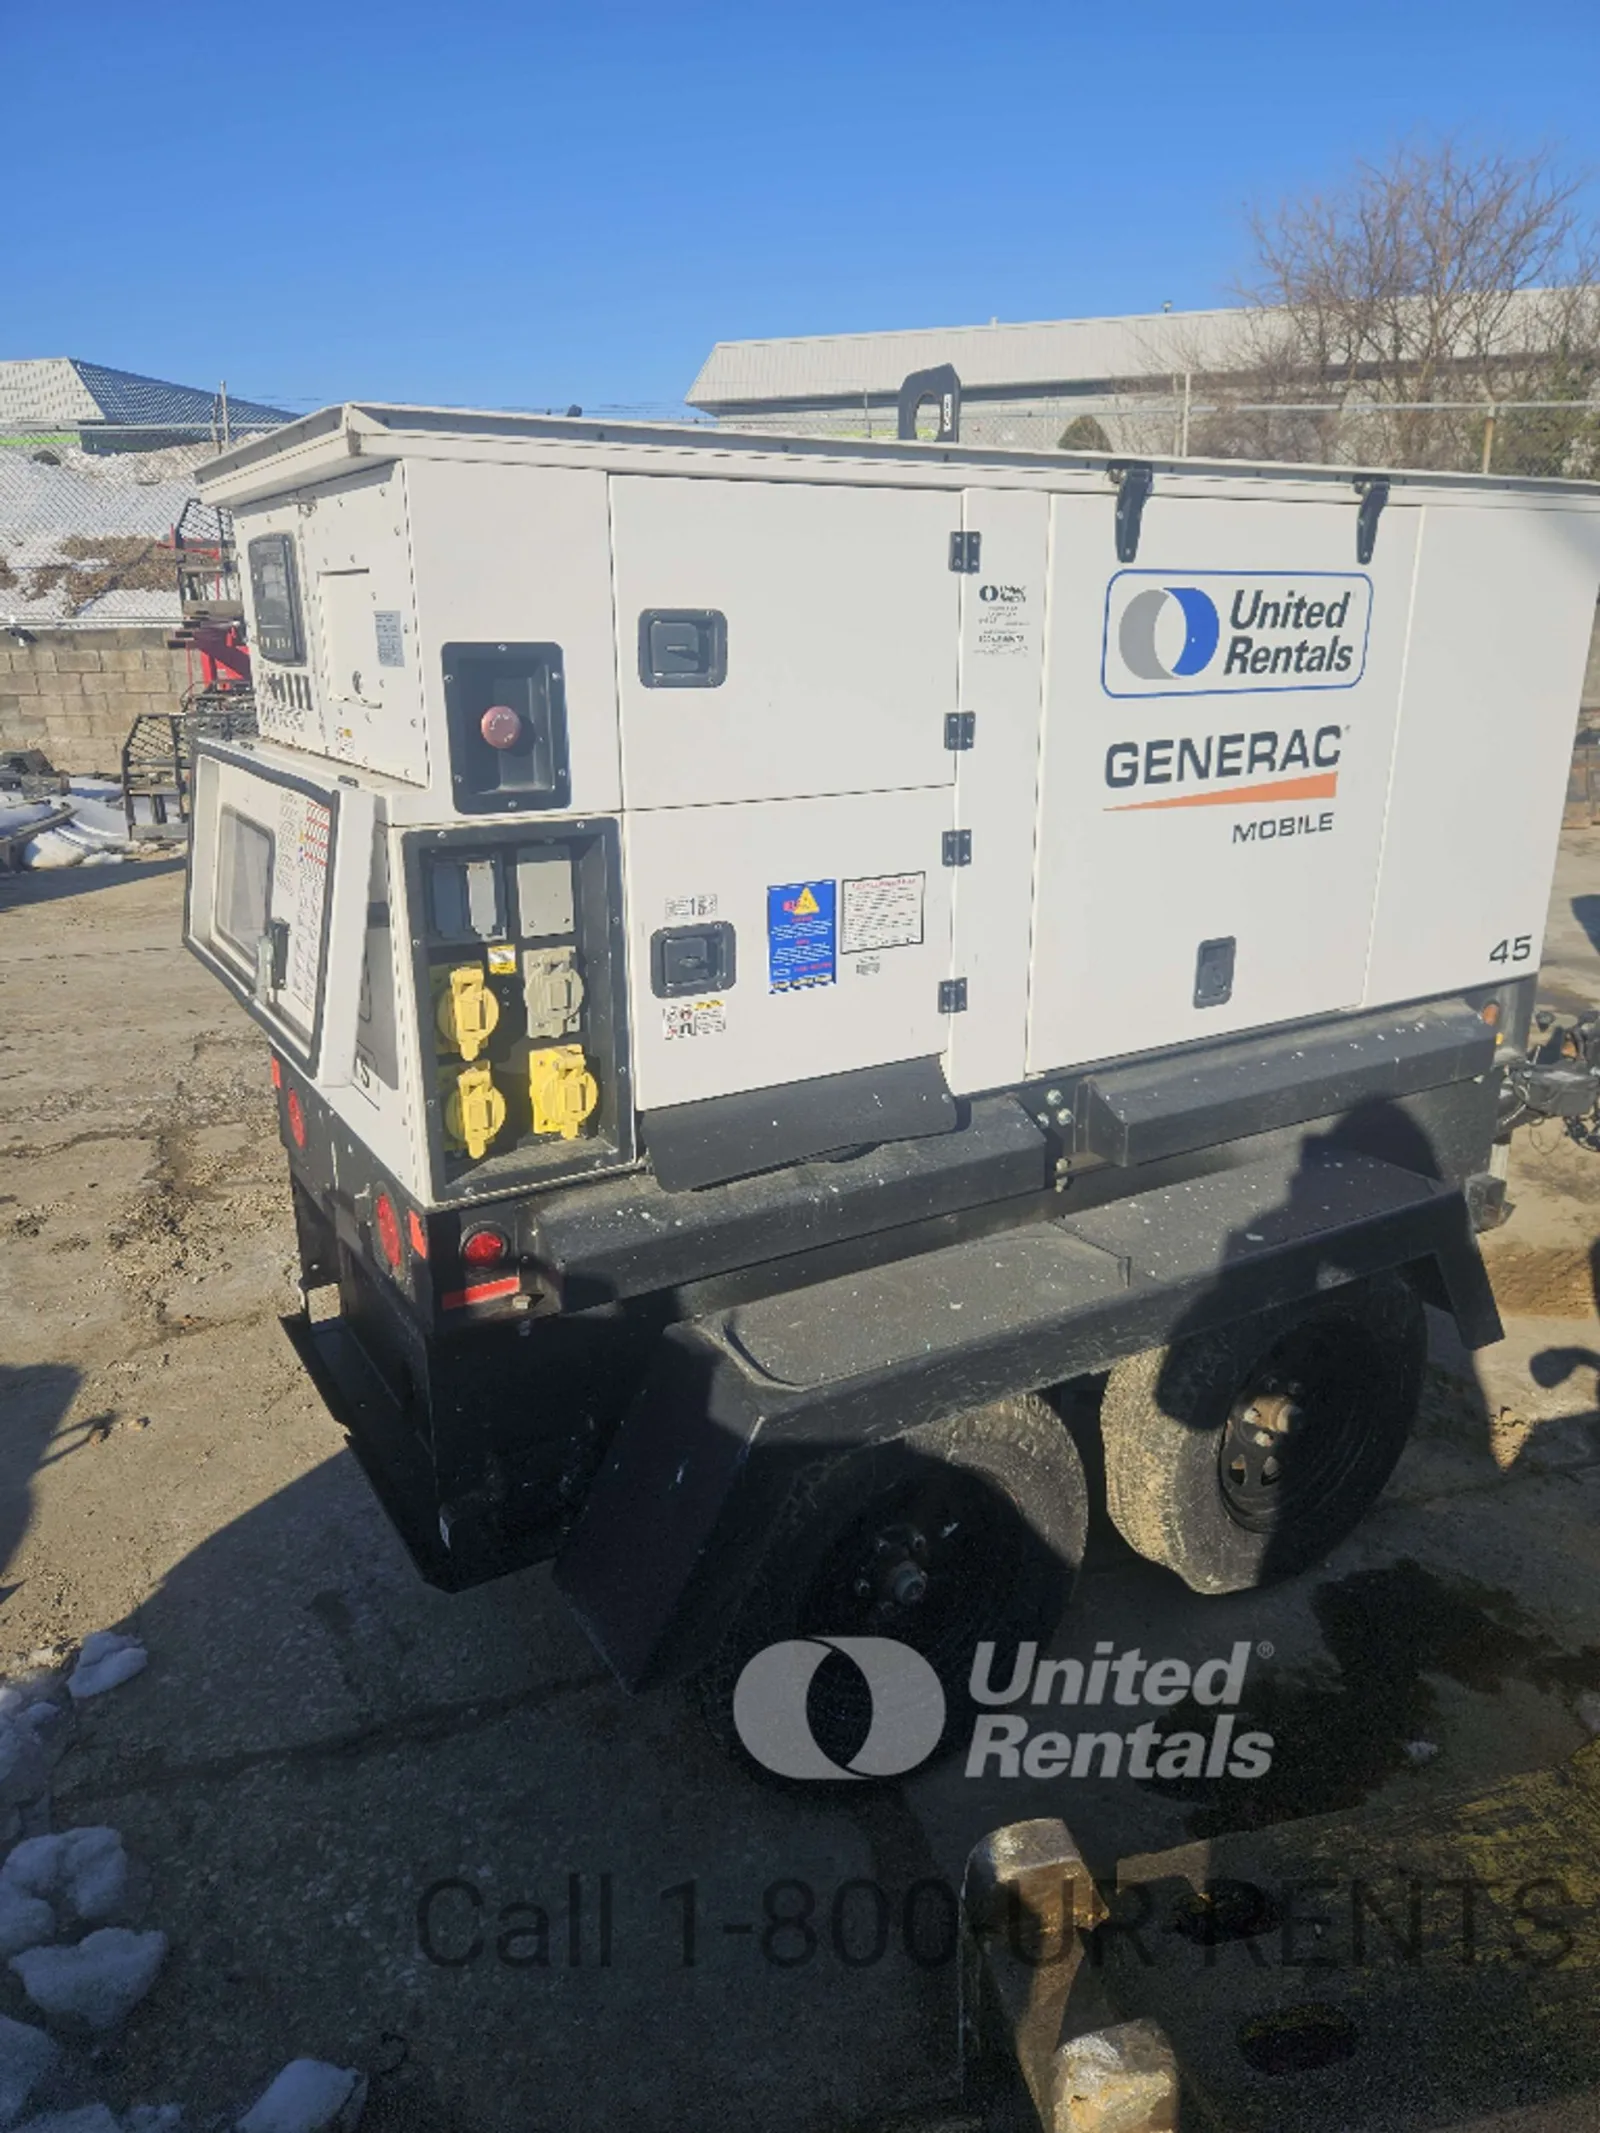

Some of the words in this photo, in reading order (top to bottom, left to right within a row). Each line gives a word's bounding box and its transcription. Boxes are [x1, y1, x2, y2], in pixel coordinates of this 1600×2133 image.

[1229, 589, 1351, 630] United
[1223, 634, 1353, 675] Rentals
[1105, 725, 1342, 789] GENERAC
[1232, 811, 1335, 844] MOBILE
[1489, 934, 1533, 965] 45
